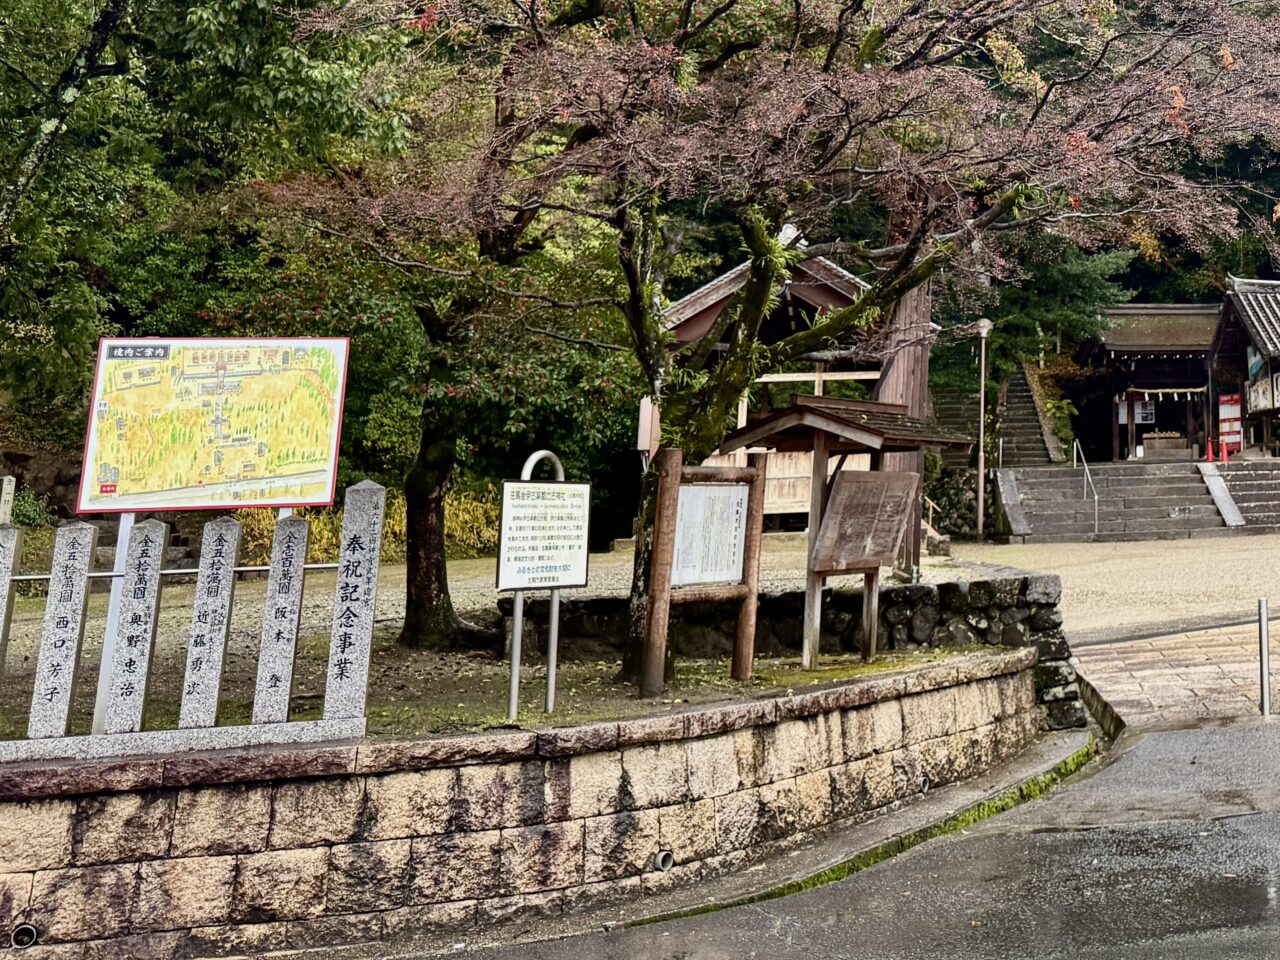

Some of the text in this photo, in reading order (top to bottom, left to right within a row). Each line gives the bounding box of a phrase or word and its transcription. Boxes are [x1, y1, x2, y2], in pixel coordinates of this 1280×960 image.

[113, 348, 165, 357] 境内ご案内
[333, 535, 366, 682] 奉祝記念事業
[43, 615, 69, 703] 西口芳子
[186, 610, 209, 696] 近藤勇次
